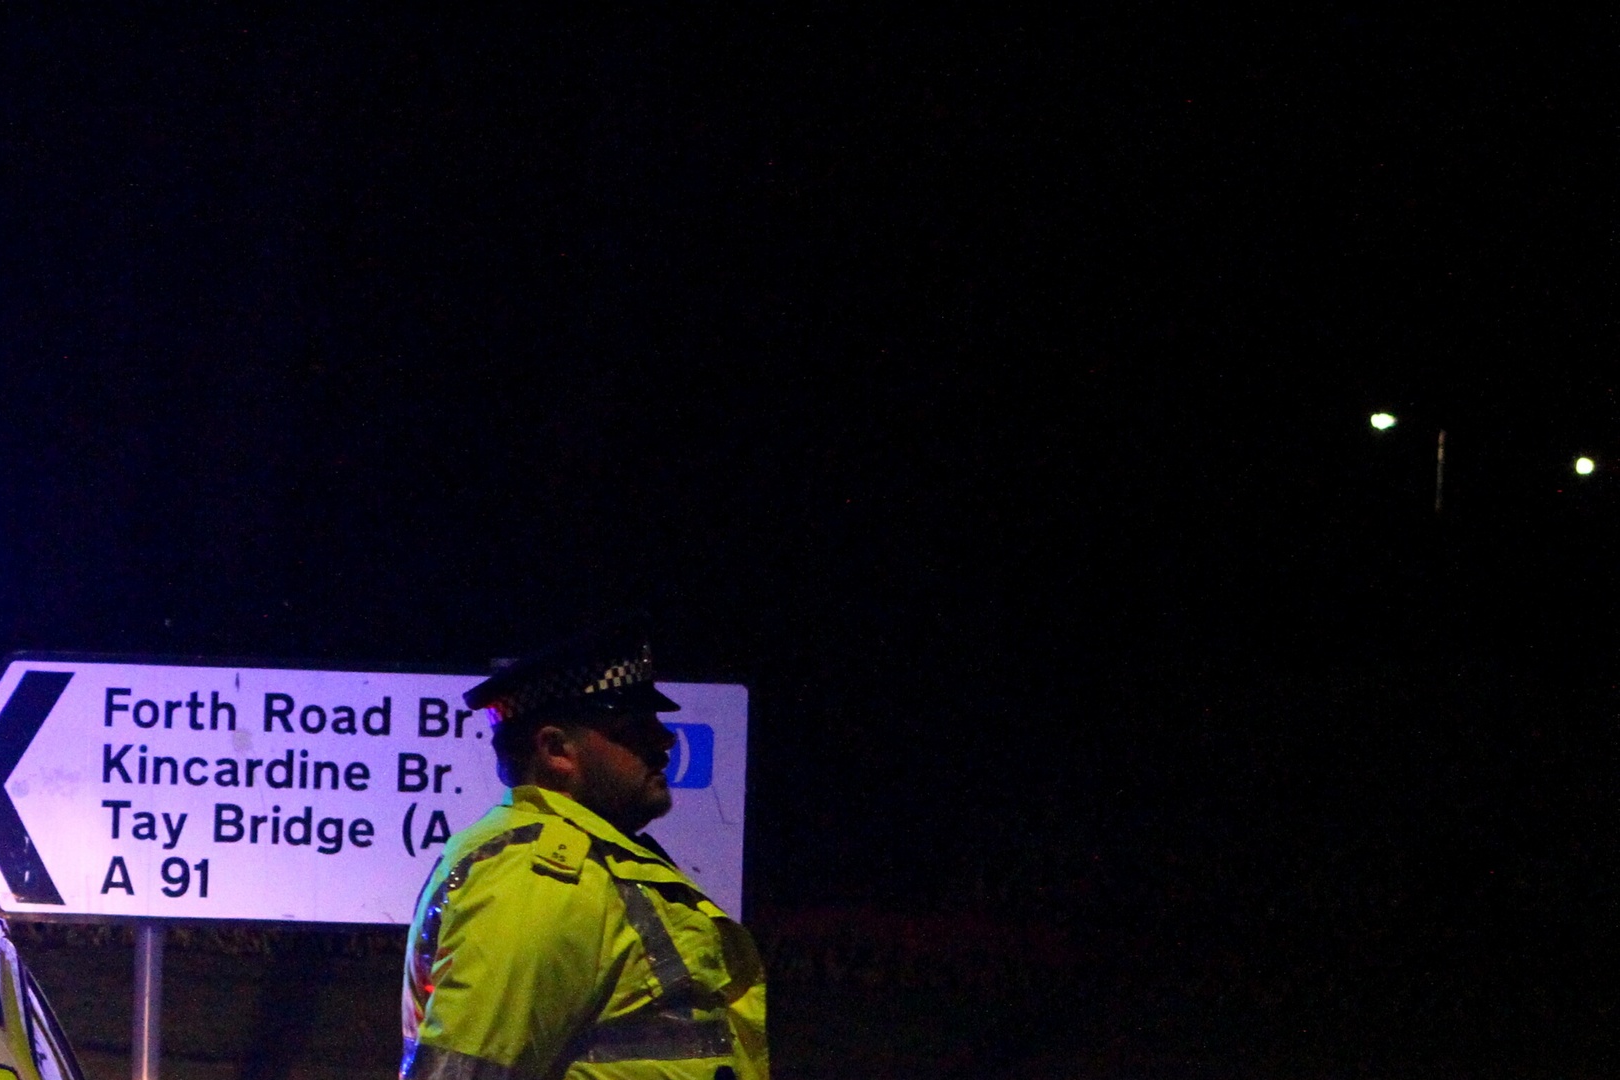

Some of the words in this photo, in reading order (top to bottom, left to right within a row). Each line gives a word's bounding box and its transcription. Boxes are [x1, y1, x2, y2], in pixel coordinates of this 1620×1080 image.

[103, 687, 237, 731] Forth
[263, 692, 392, 736] Road
[417, 697, 483, 739] Br.
[101, 743, 371, 791] Kincardine
[396, 752, 462, 794] Br.
[101, 799, 188, 849] Tay
[213, 803, 375, 854] Bridge
[100, 855, 135, 896] A
[160, 856, 209, 898] 91
